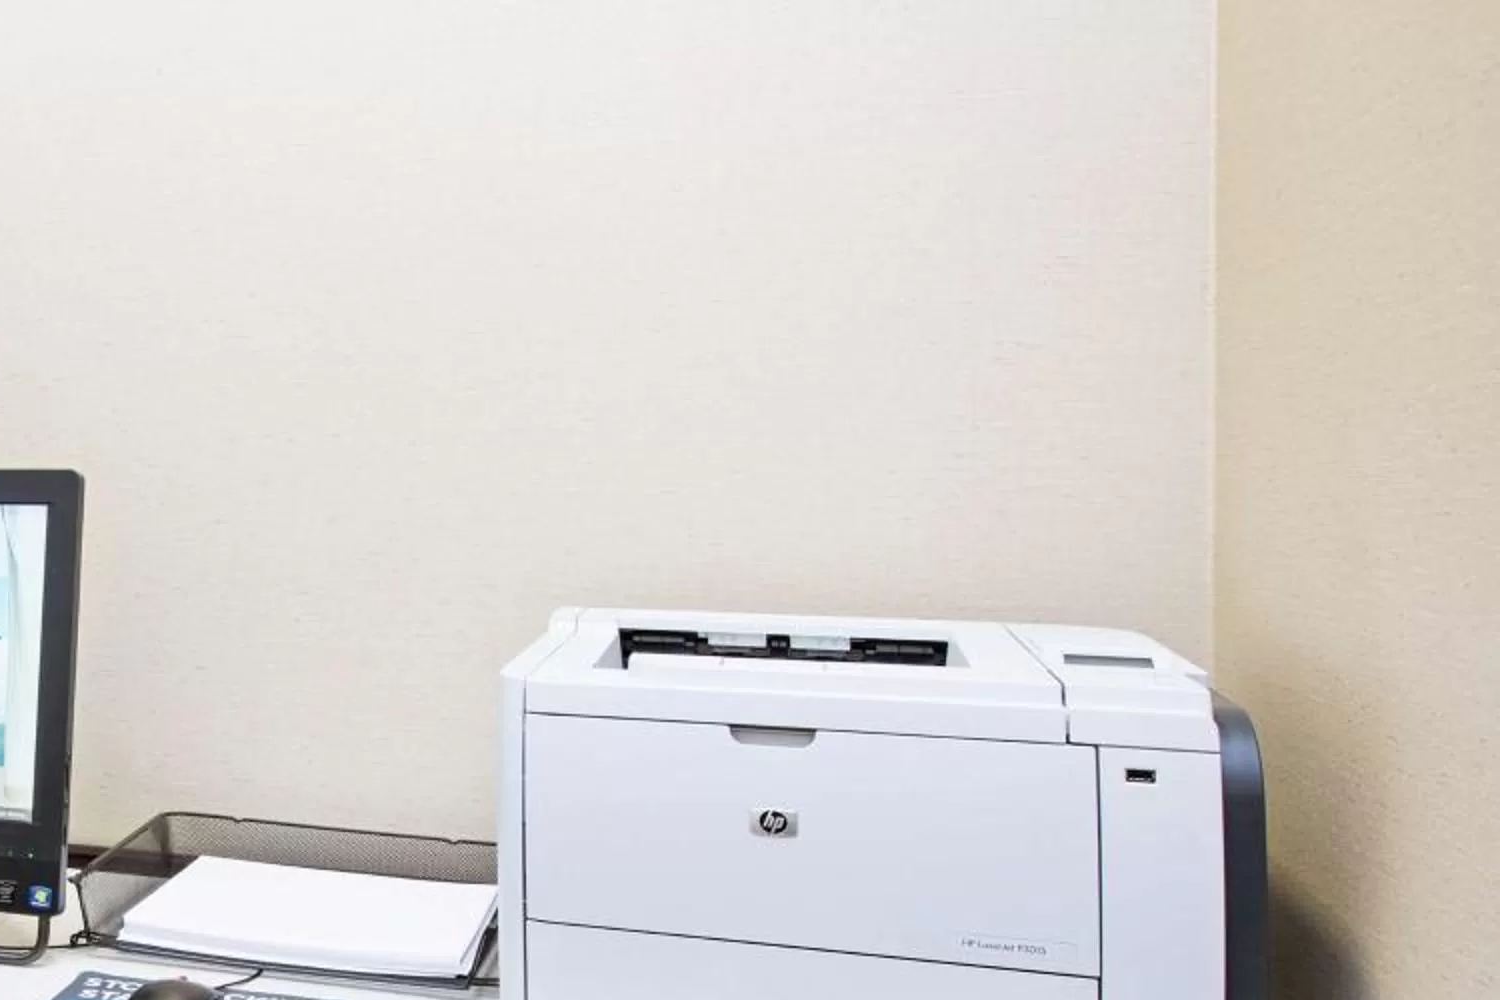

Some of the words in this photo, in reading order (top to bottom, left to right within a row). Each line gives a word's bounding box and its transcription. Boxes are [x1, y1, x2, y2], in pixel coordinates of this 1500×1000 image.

[762, 810, 787, 836] hp
[83, 977, 141, 991] STO
[77, 989, 131, 1000] STA
